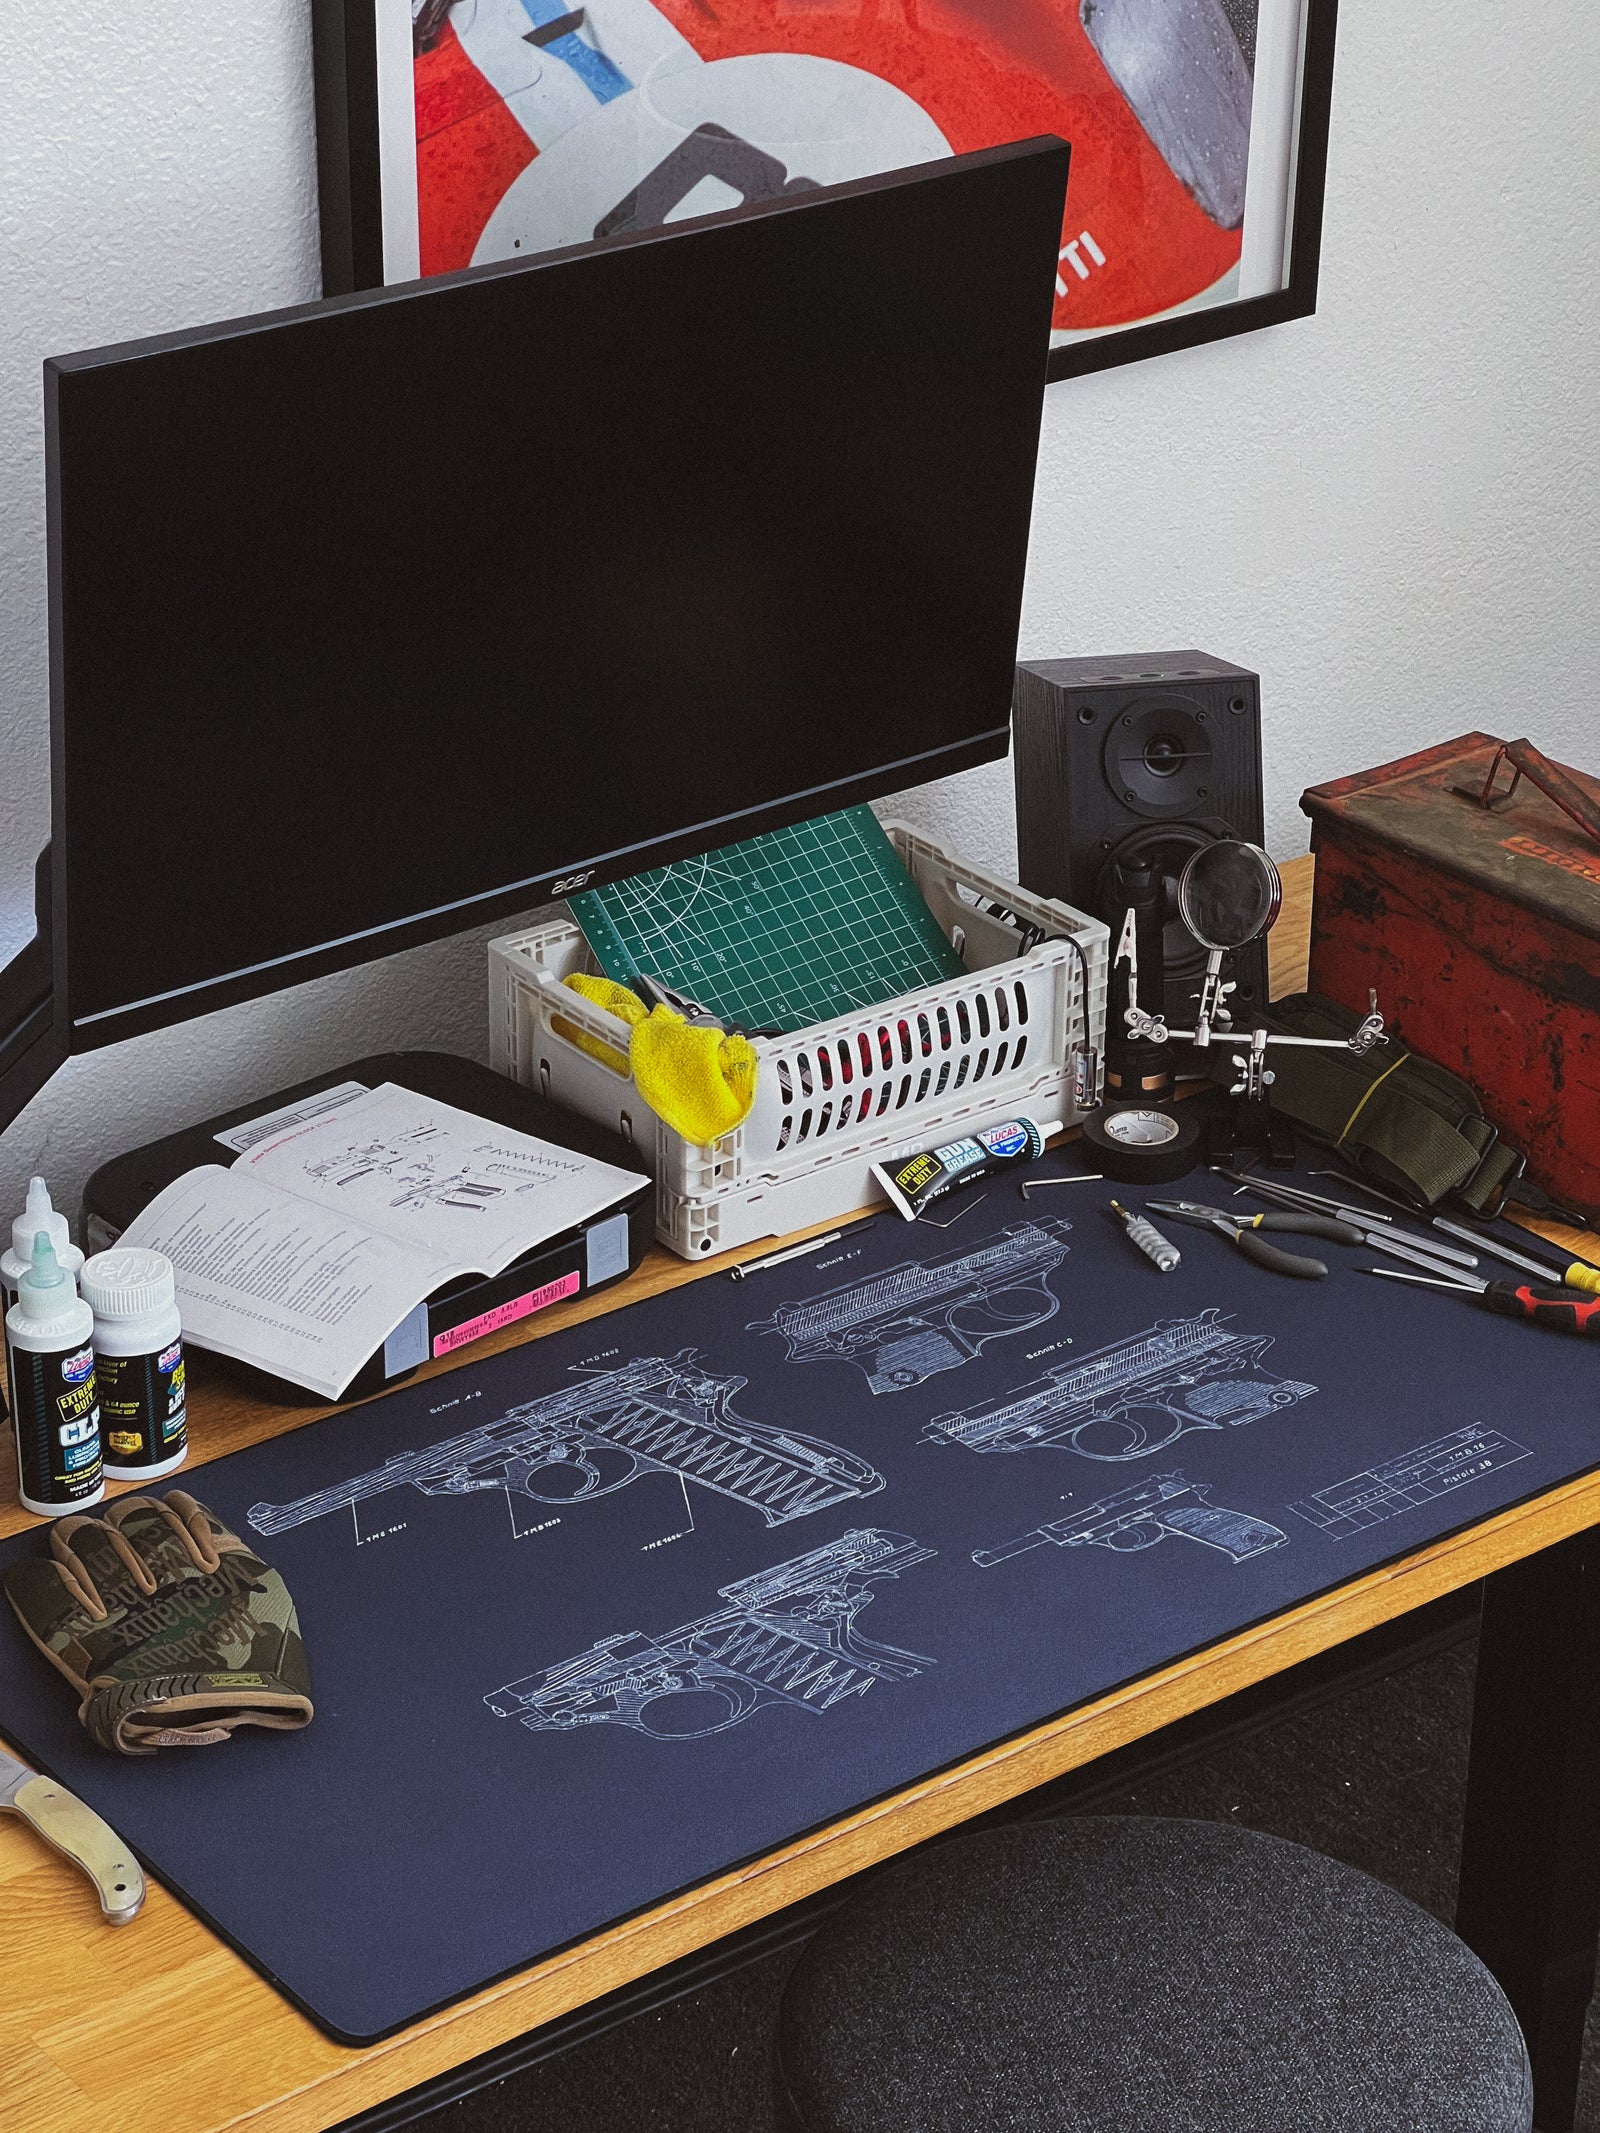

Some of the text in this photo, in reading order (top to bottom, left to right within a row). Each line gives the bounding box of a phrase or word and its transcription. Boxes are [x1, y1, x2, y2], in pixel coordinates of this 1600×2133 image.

[551, 869, 596, 895] acer
[990, 1125, 1018, 1144] LUCAS
[935, 1138, 979, 1162] GUN
[944, 1147, 986, 1172] GREASE
[899, 1155, 931, 1185] EXTREME
[912, 1166, 933, 1186] DUTY
[60, 1375, 96, 1409] EXTREME
[73, 1390, 94, 1414] DUTY
[1442, 1467, 1476, 1486] Pistole
[112, 1550, 260, 1647] Mechanix
[114, 1603, 267, 1675] Mechanix
